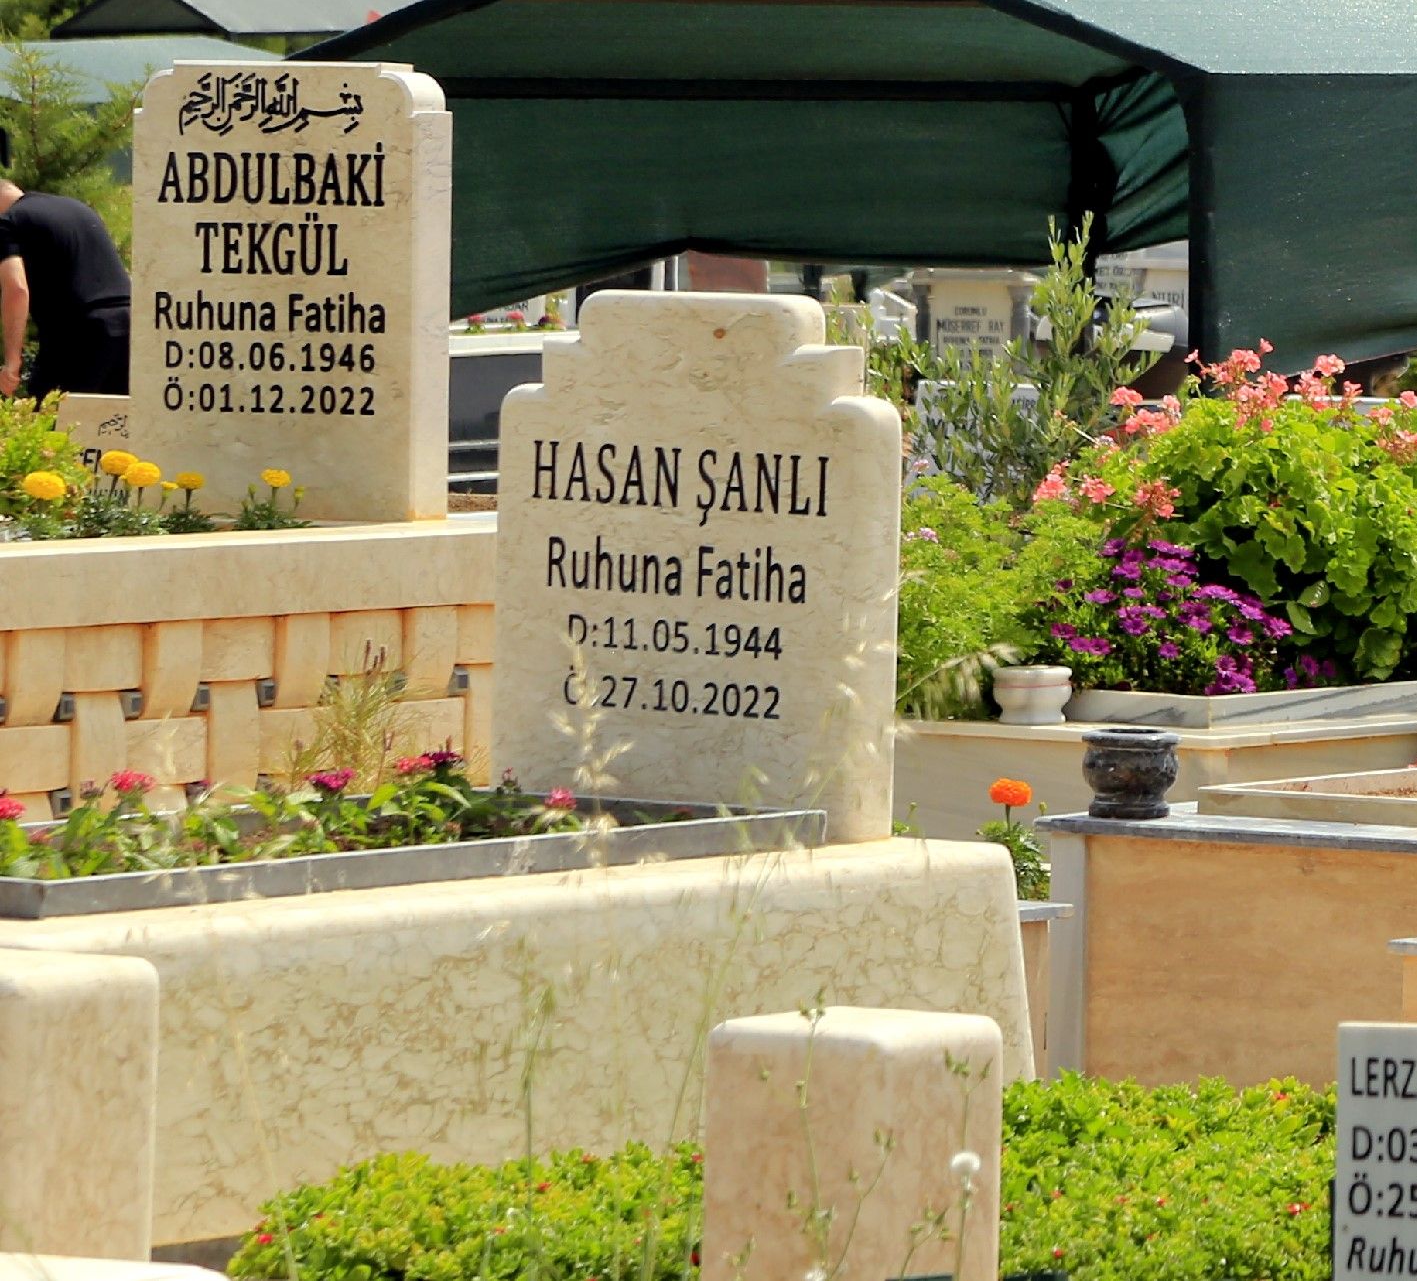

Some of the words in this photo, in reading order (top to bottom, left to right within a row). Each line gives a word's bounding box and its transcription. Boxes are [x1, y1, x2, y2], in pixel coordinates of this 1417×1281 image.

[158, 142, 385, 207] ABDULBAKİ
[195, 212, 348, 276] TEKGÜL
[155, 290, 276, 331] Ruhuna
[288, 293, 386, 334] Fatiha
[165, 340, 376, 373] D:08.06.1946
[164, 376, 376, 416] Ö:01.12.2022
[532, 439, 682, 508] HASAN
[697, 449, 830, 527] ŞANLI
[547, 535, 682, 597] Ruhuna
[697, 546, 807, 604] Fatiha
[568, 613, 783, 660] D:11.05.1944
[563, 665, 781, 720] Ö27.10.2022
